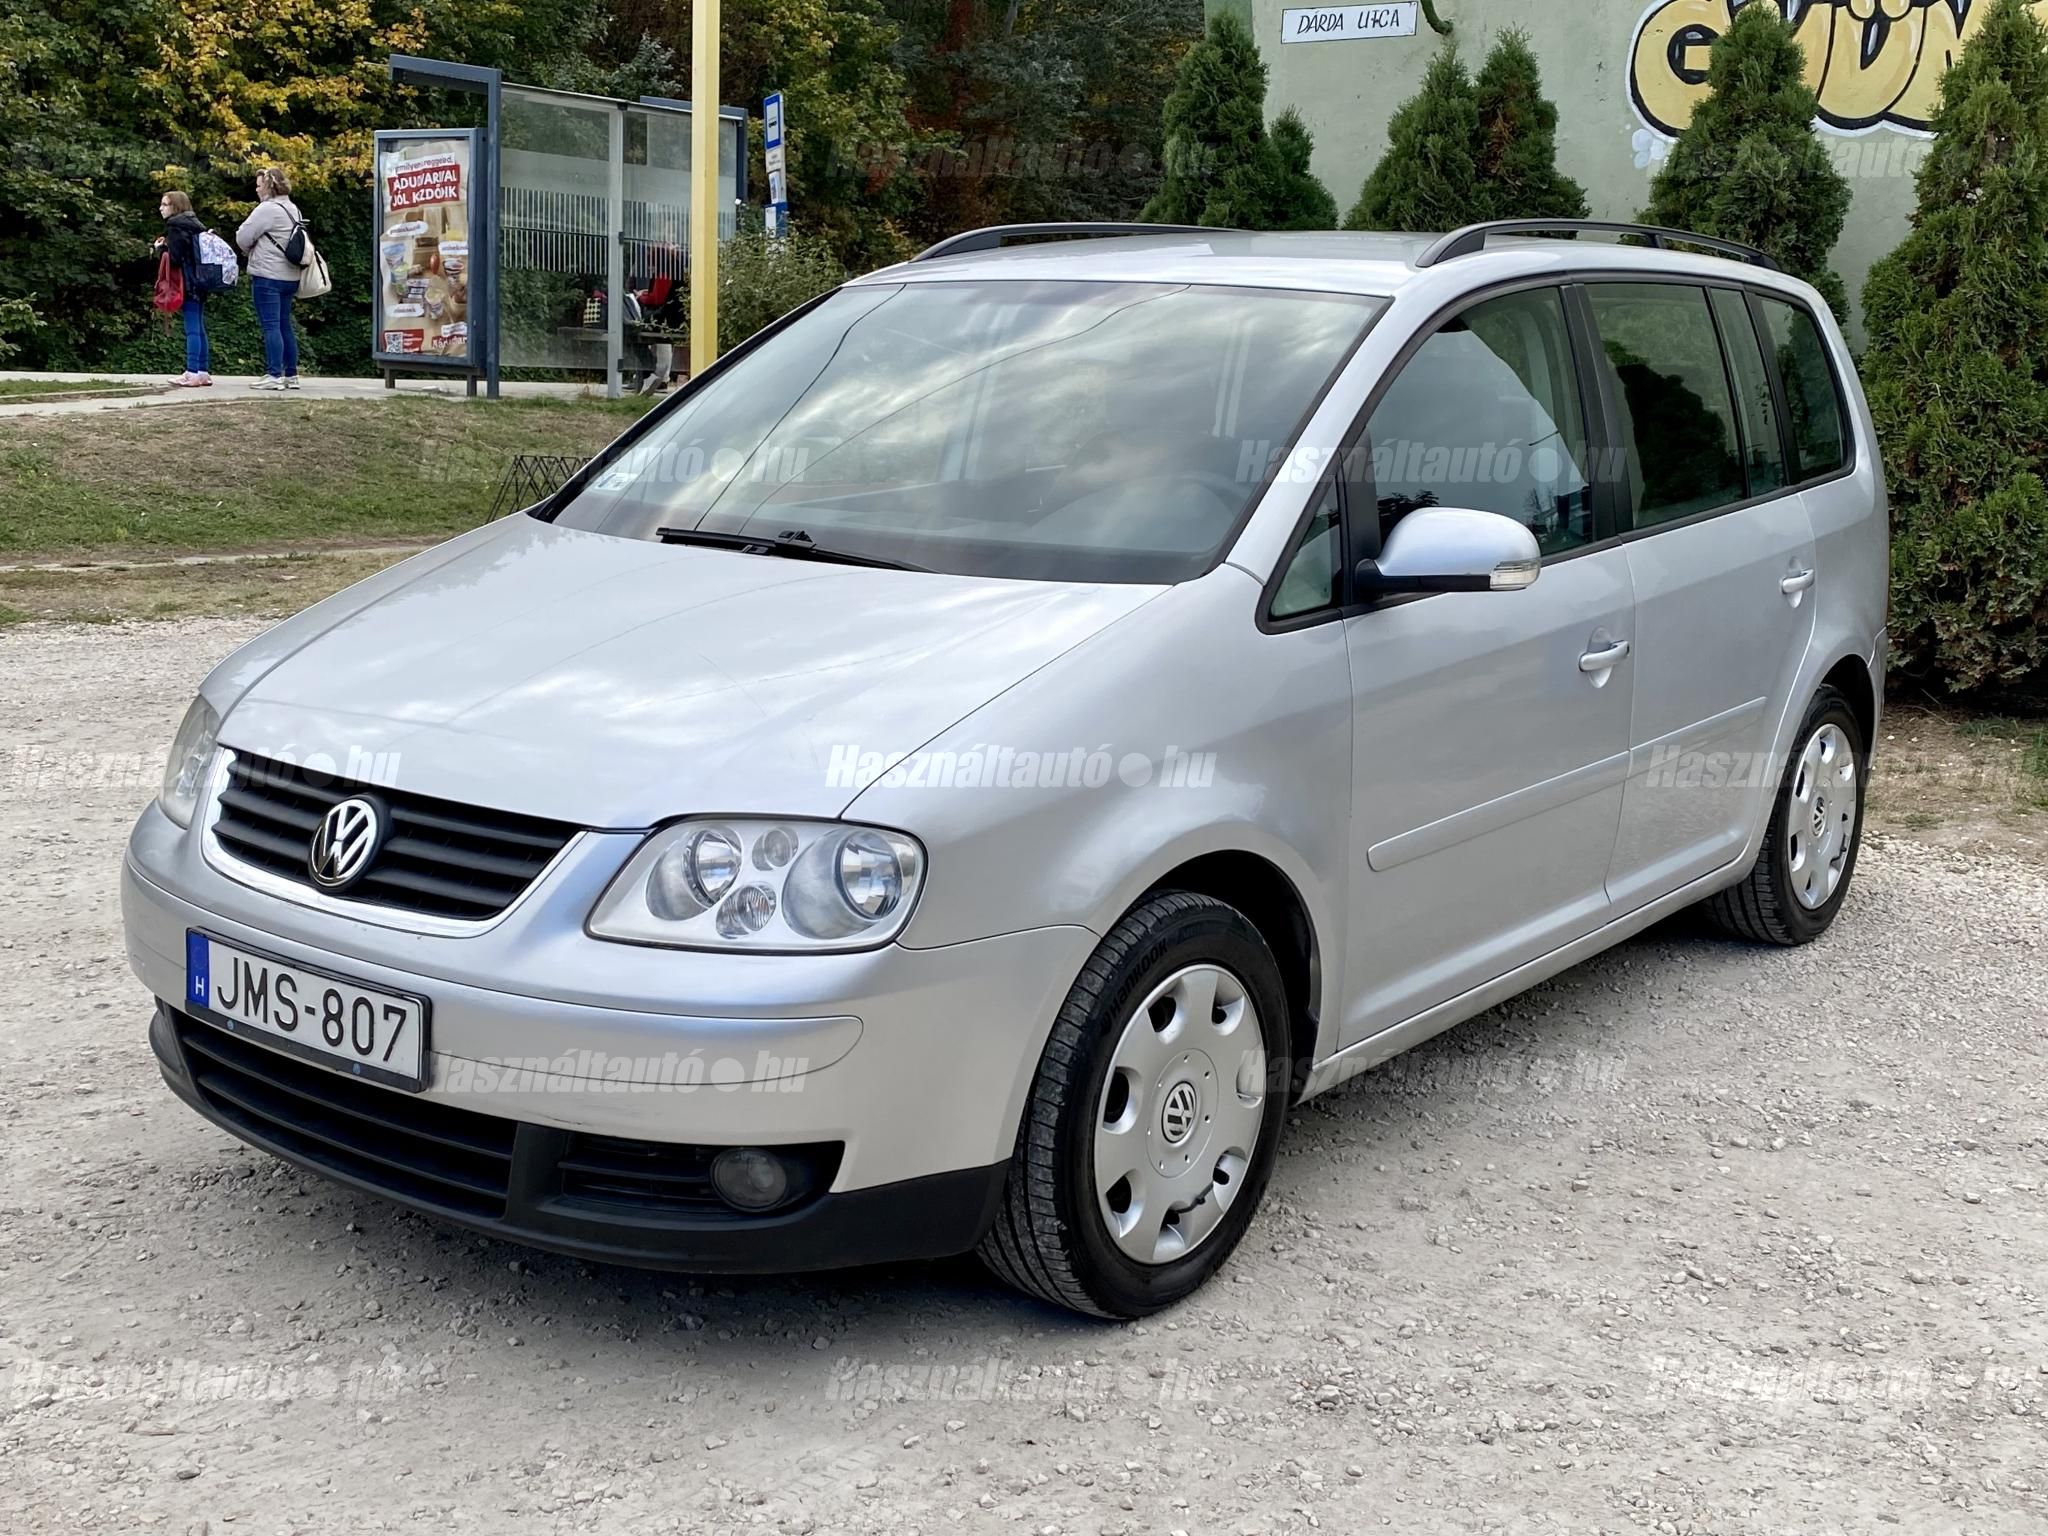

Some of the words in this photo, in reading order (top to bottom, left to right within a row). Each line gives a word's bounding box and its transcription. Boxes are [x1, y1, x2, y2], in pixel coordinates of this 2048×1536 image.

[1297, 10, 1344, 35] DÁRDA
[392, 191, 410, 207] JÓL
[195, 975, 205, 997] H
[217, 957, 407, 1062] JMS-807
